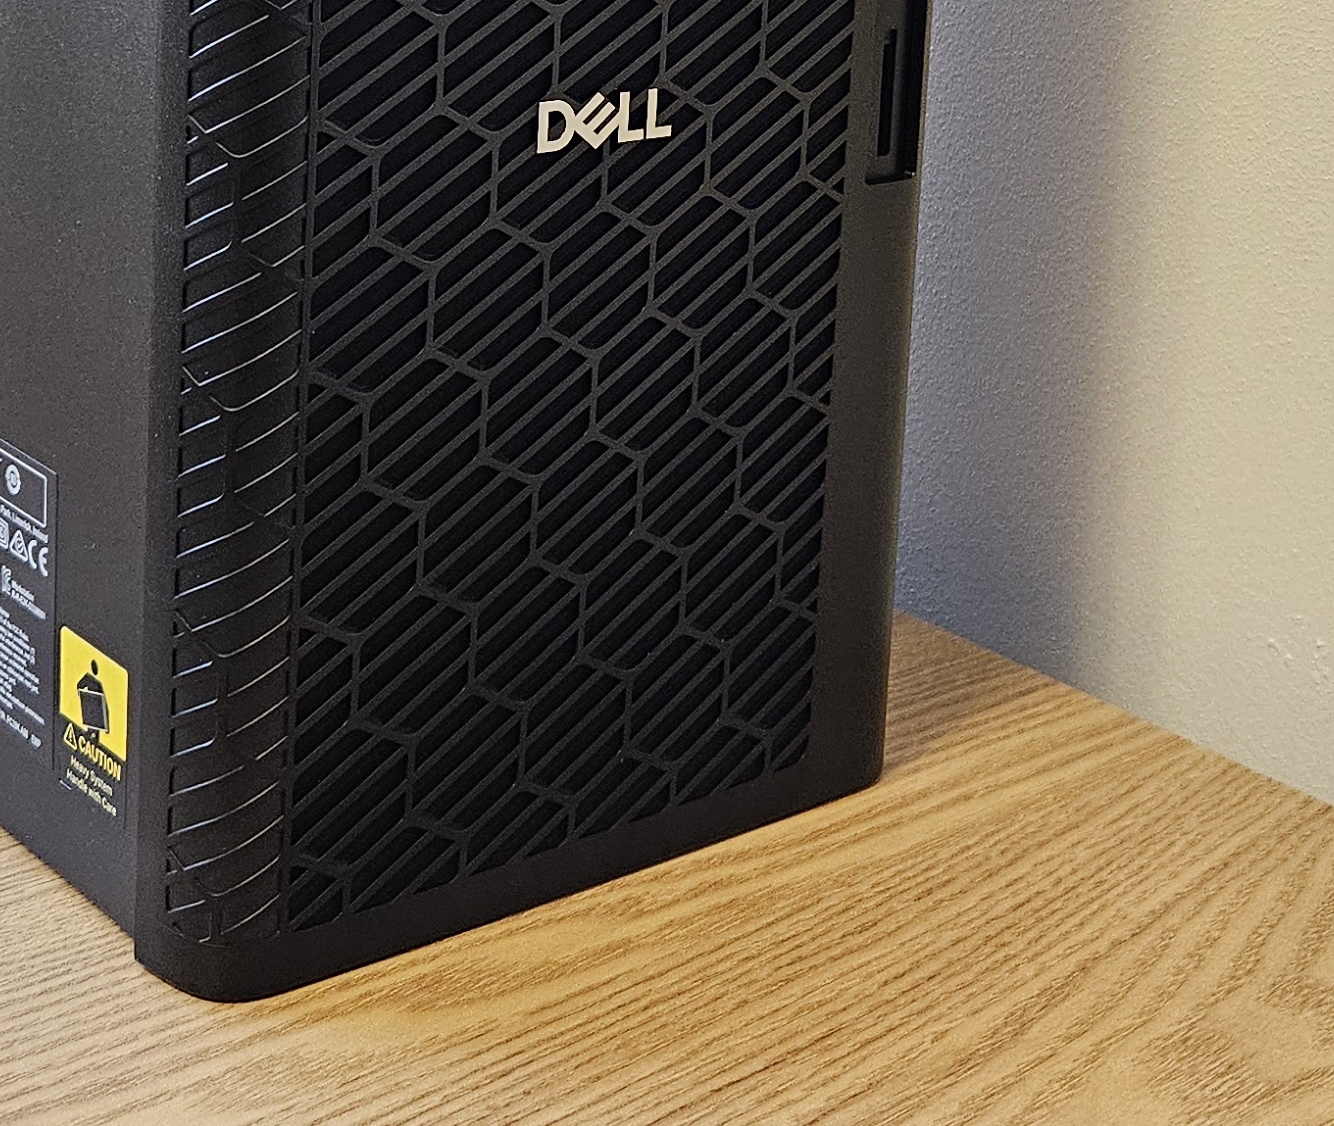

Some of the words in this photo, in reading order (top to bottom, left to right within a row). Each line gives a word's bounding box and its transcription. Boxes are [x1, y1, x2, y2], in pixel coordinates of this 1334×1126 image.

[537, 88, 672, 150] DELL
[70, 754, 89, 779] Heavy
[90, 770, 113, 796] System
[78, 735, 121, 781] CAUTION
[66, 768, 88, 793] Handle
[101, 796, 117, 816] Care
